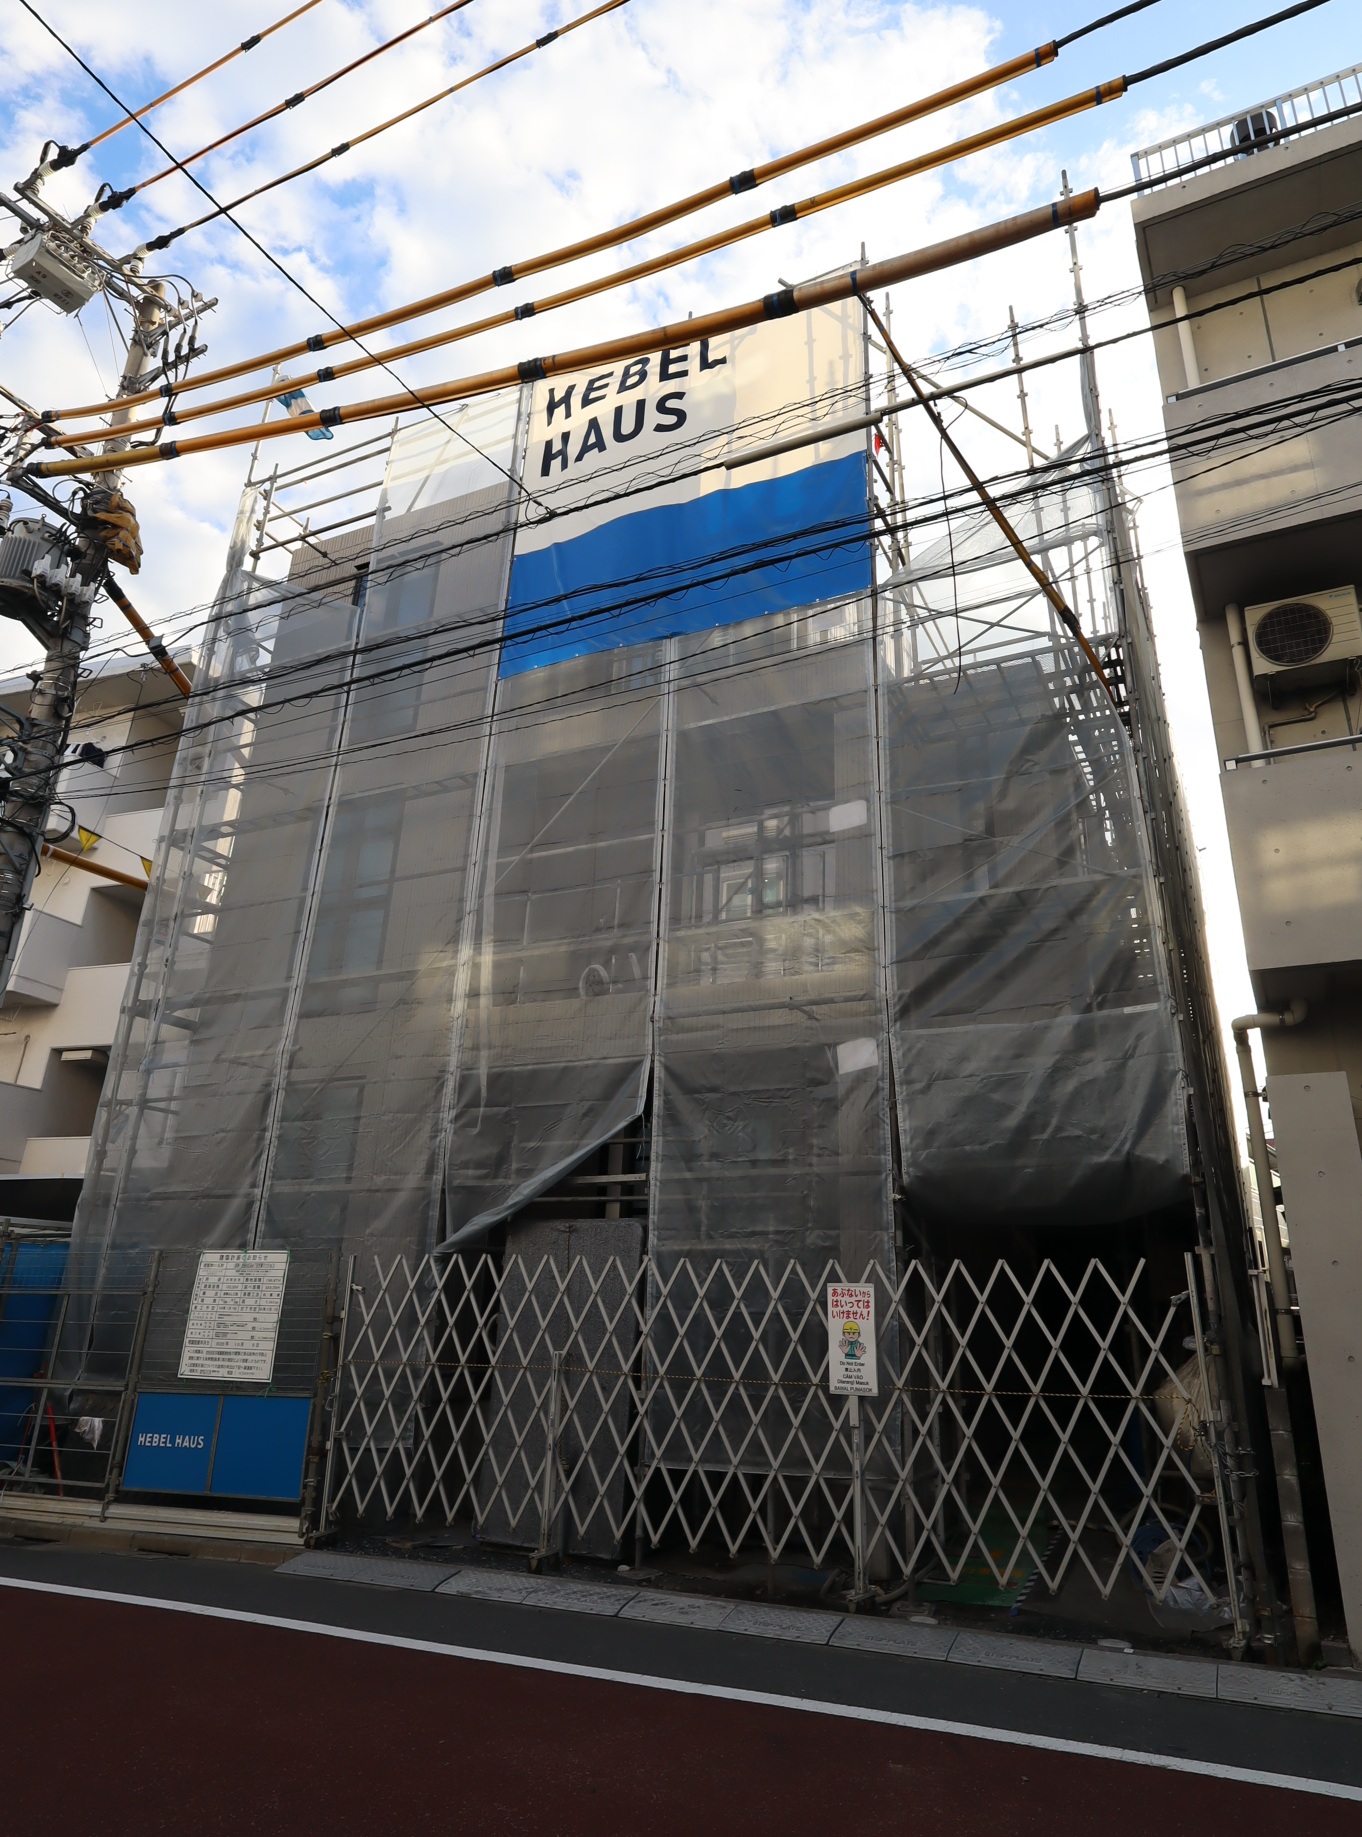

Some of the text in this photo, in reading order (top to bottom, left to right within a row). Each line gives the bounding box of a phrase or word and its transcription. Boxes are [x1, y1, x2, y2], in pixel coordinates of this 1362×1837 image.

[546, 338, 727, 428] HEBEL
[540, 391, 687, 478] HAUS
[831, 1288, 871, 1298] あぶないから
[831, 1299, 871, 1309] はいっては
[138, 1433, 204, 1448] HEBEL HAUS
